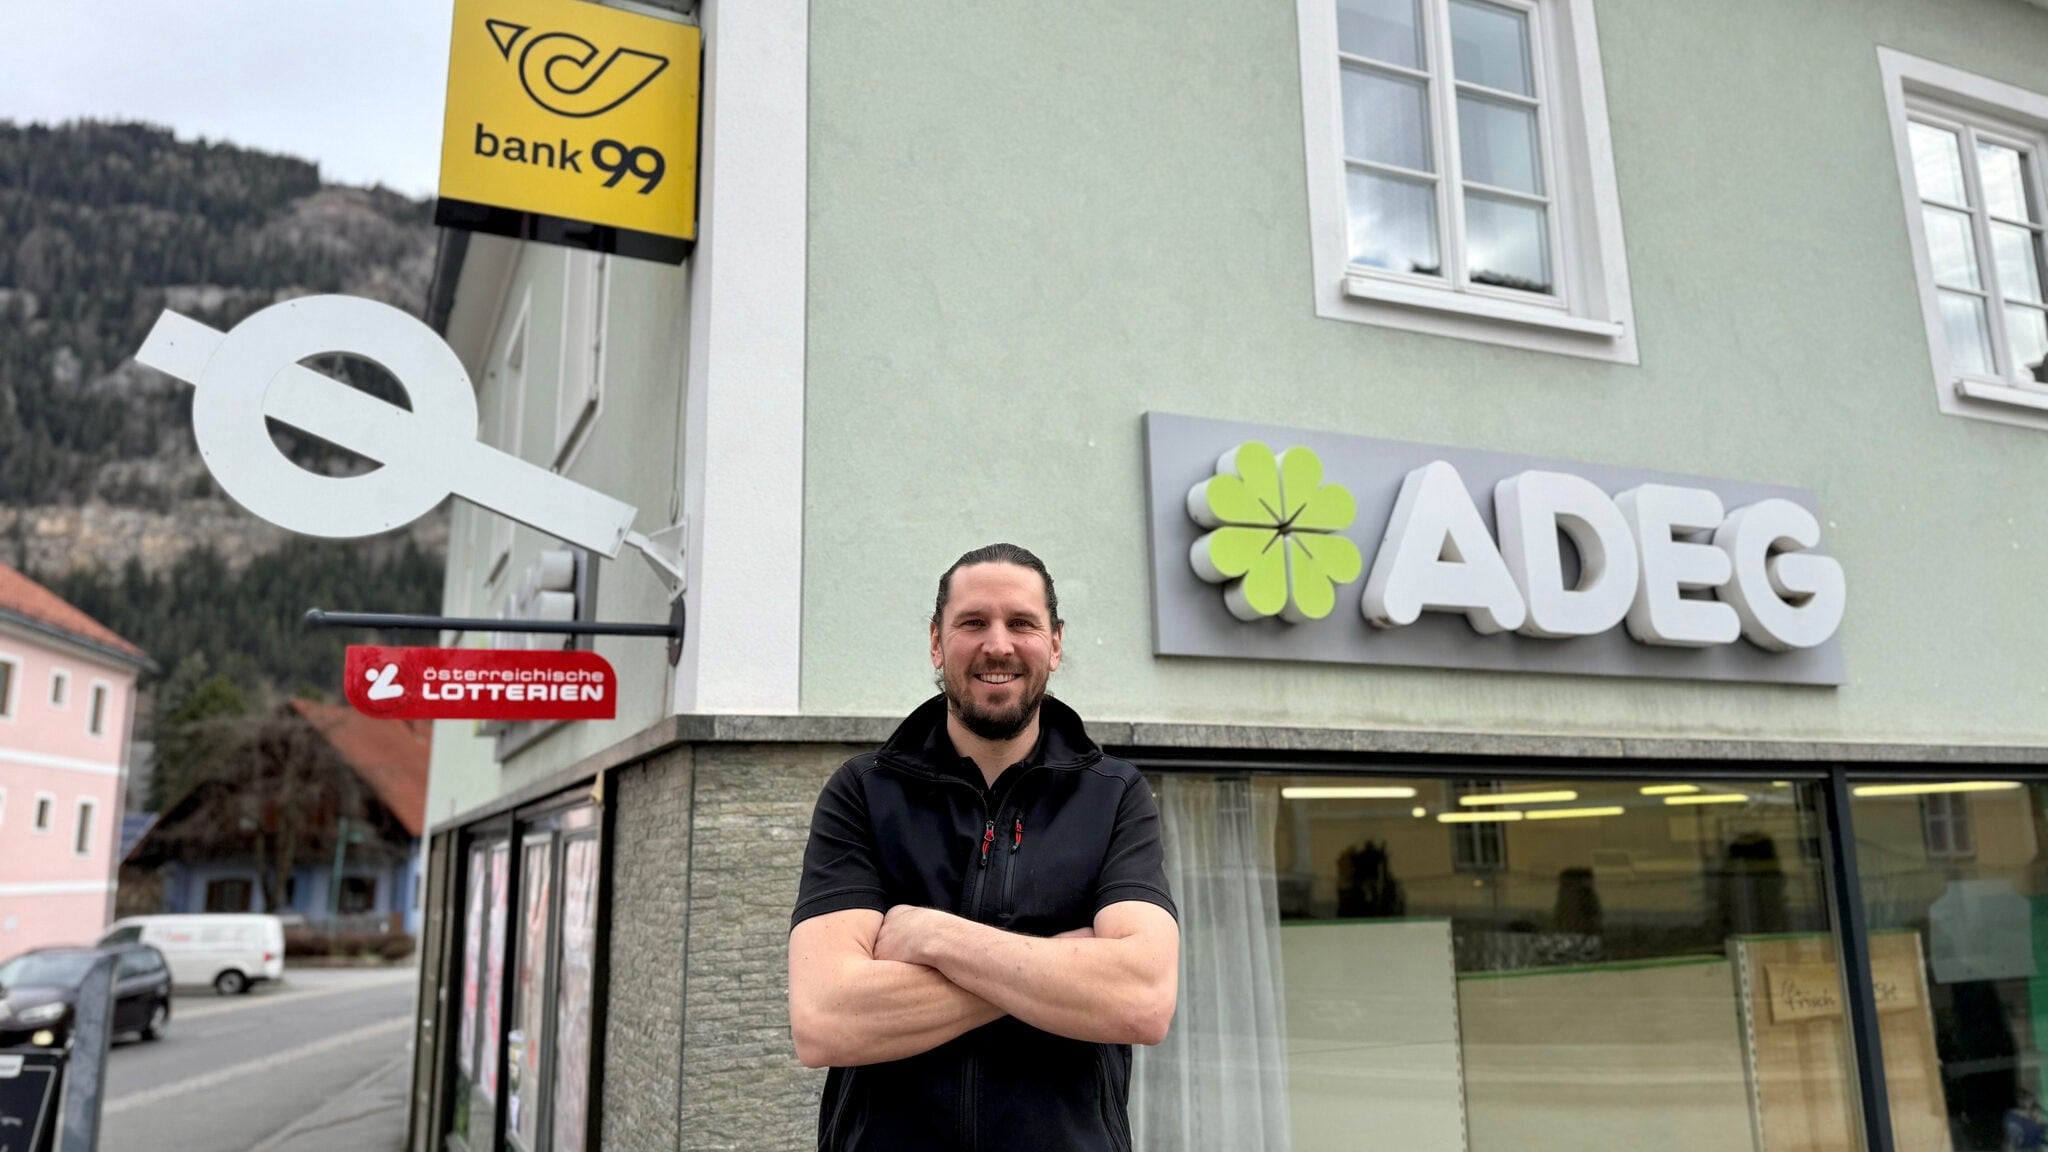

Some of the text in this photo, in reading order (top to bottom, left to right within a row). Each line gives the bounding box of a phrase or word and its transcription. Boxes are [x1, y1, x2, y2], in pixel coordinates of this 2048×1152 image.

[1362, 458, 1846, 652] ADEG
[422, 666, 604, 683] österreichische
[421, 683, 604, 701] LOTTERIEN
